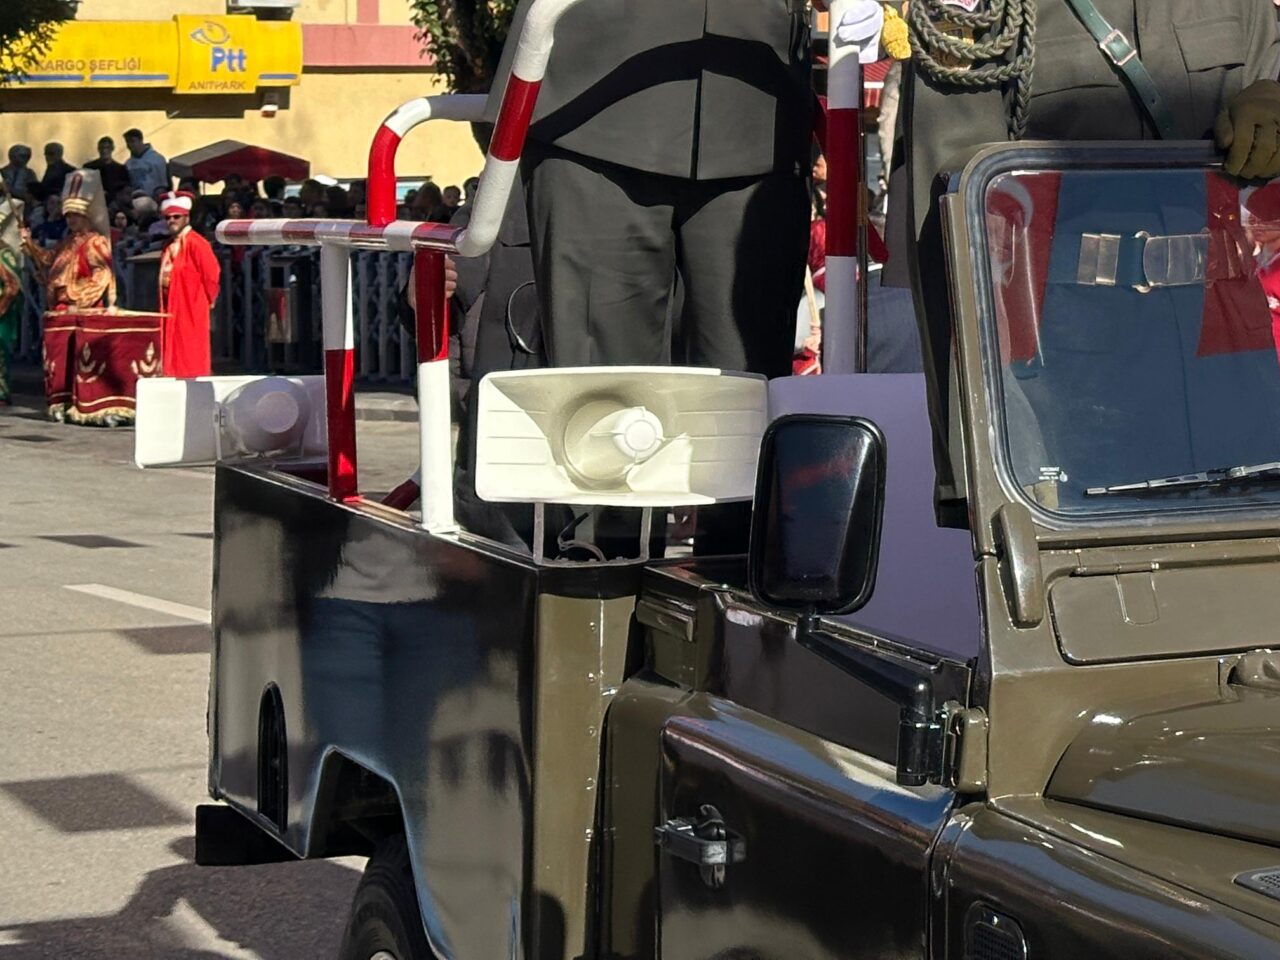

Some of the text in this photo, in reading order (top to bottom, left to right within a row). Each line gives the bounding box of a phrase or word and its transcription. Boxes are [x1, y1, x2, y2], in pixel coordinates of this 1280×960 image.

[35, 57, 142, 72] KARGO ŞEFLİĞİ
[211, 47, 248, 72] Ptt
[188, 80, 247, 91] ANITPARK
